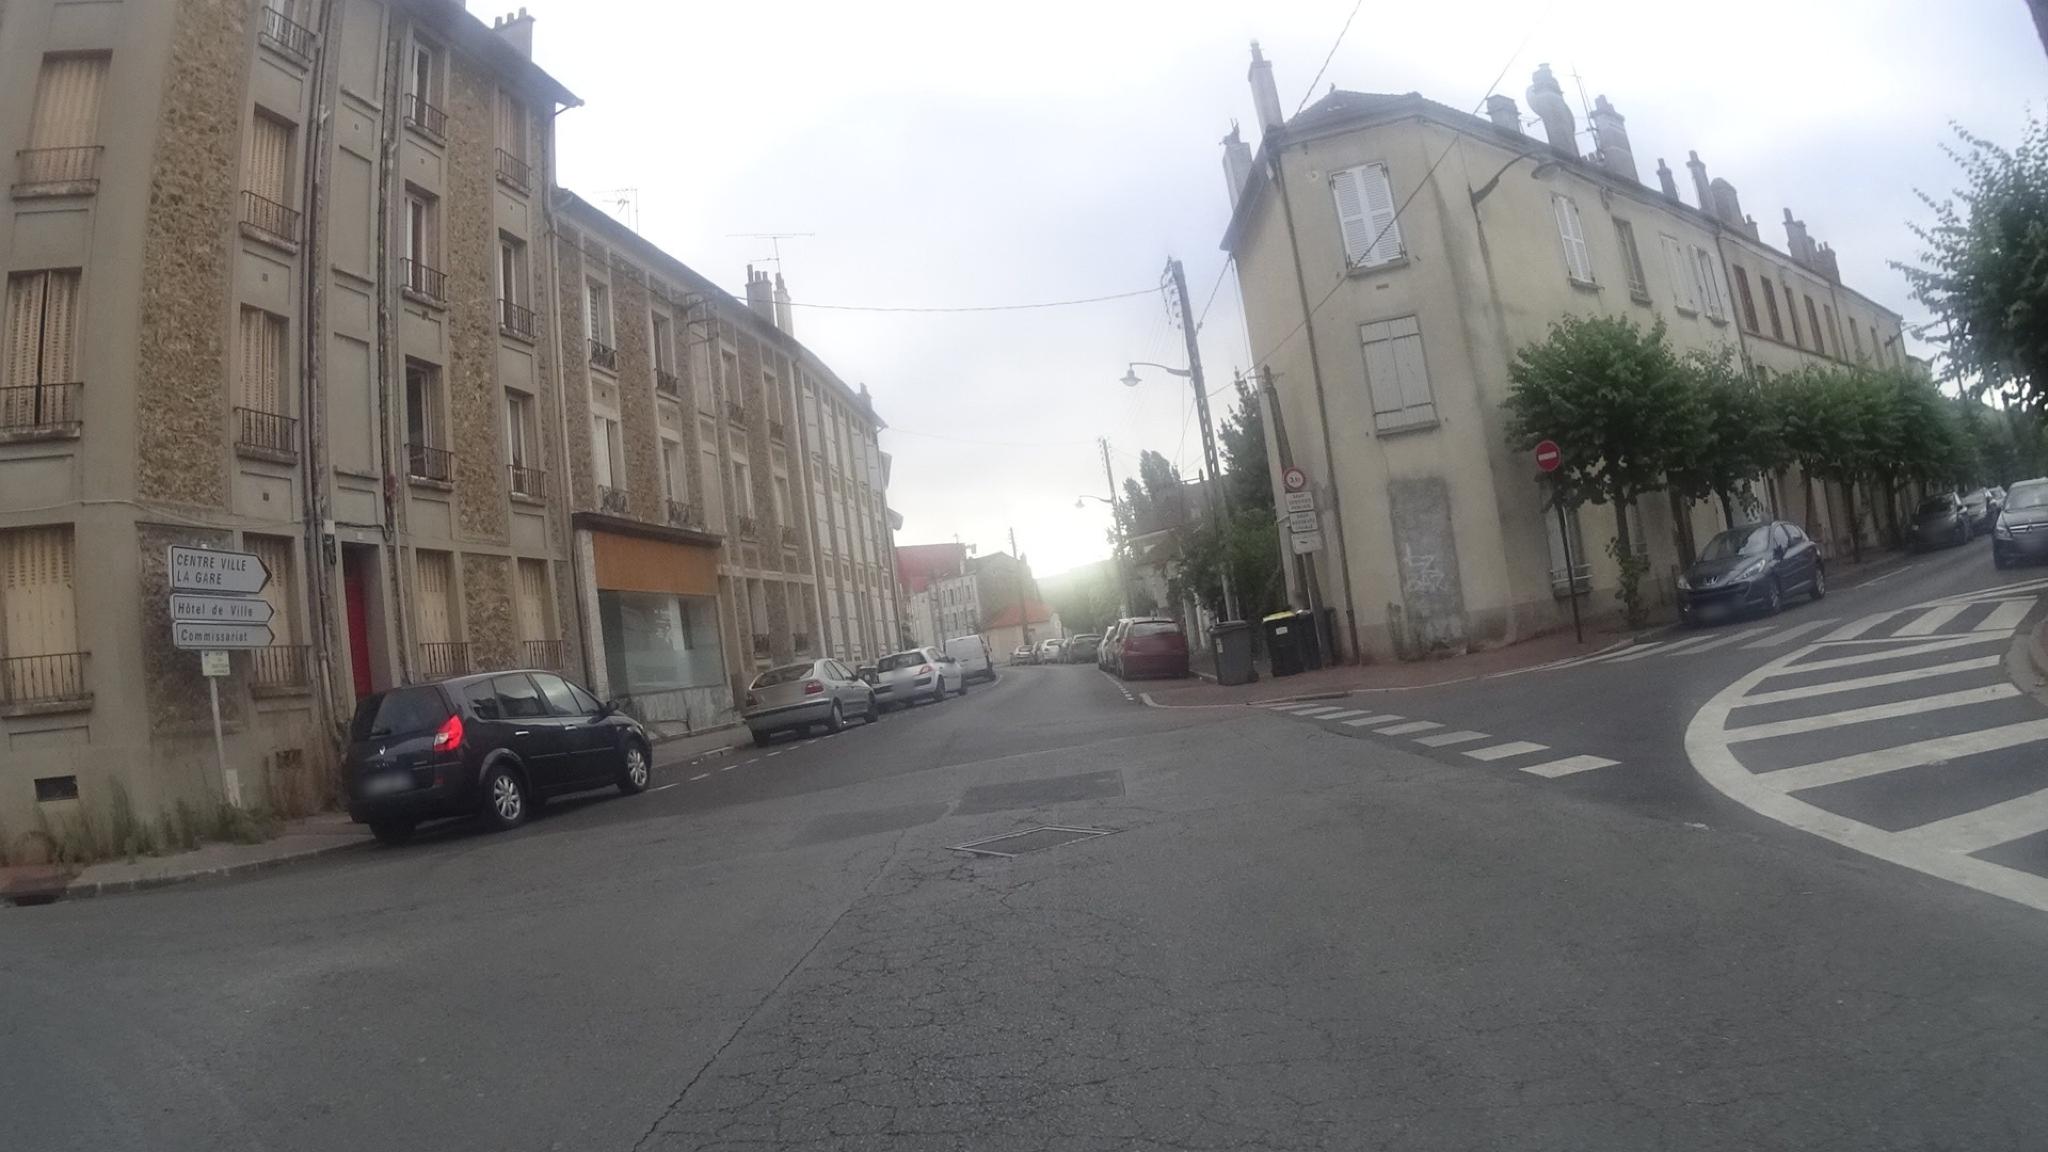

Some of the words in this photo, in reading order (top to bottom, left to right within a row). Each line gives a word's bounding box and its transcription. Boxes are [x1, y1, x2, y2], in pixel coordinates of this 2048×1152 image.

[176, 553, 215, 569] CENTRE
[221, 557, 247, 572] VILLE
[177, 570, 190, 582] LA
[195, 572, 222, 585] GARE
[178, 602, 206, 615] Hôtel
[211, 604, 224, 616] de
[230, 605, 253, 617] Ville
[181, 628, 248, 642] Commissariat
